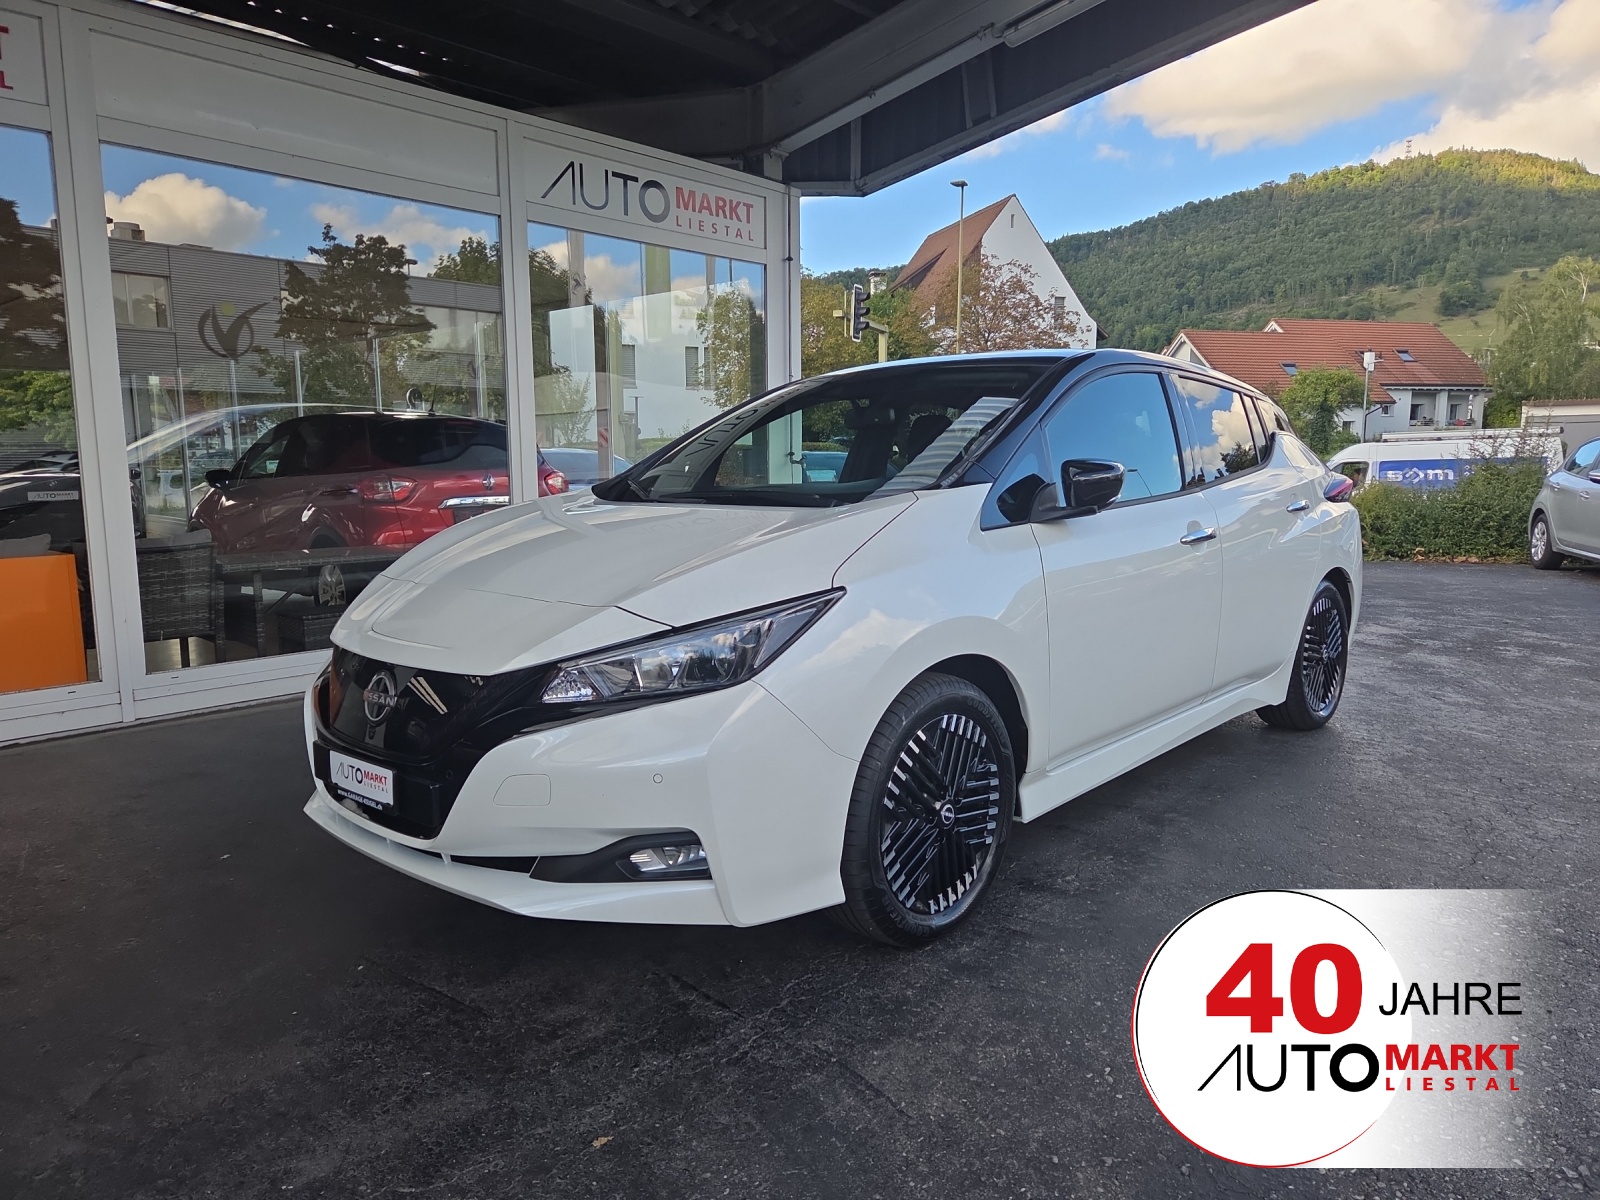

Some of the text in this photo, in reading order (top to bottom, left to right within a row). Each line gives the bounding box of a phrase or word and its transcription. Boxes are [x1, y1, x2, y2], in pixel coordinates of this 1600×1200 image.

[540, 160, 754, 224] AUTO MARKT
[675, 215, 754, 241] LIESTAL
[336, 761, 388, 787] AUTO MARKT
